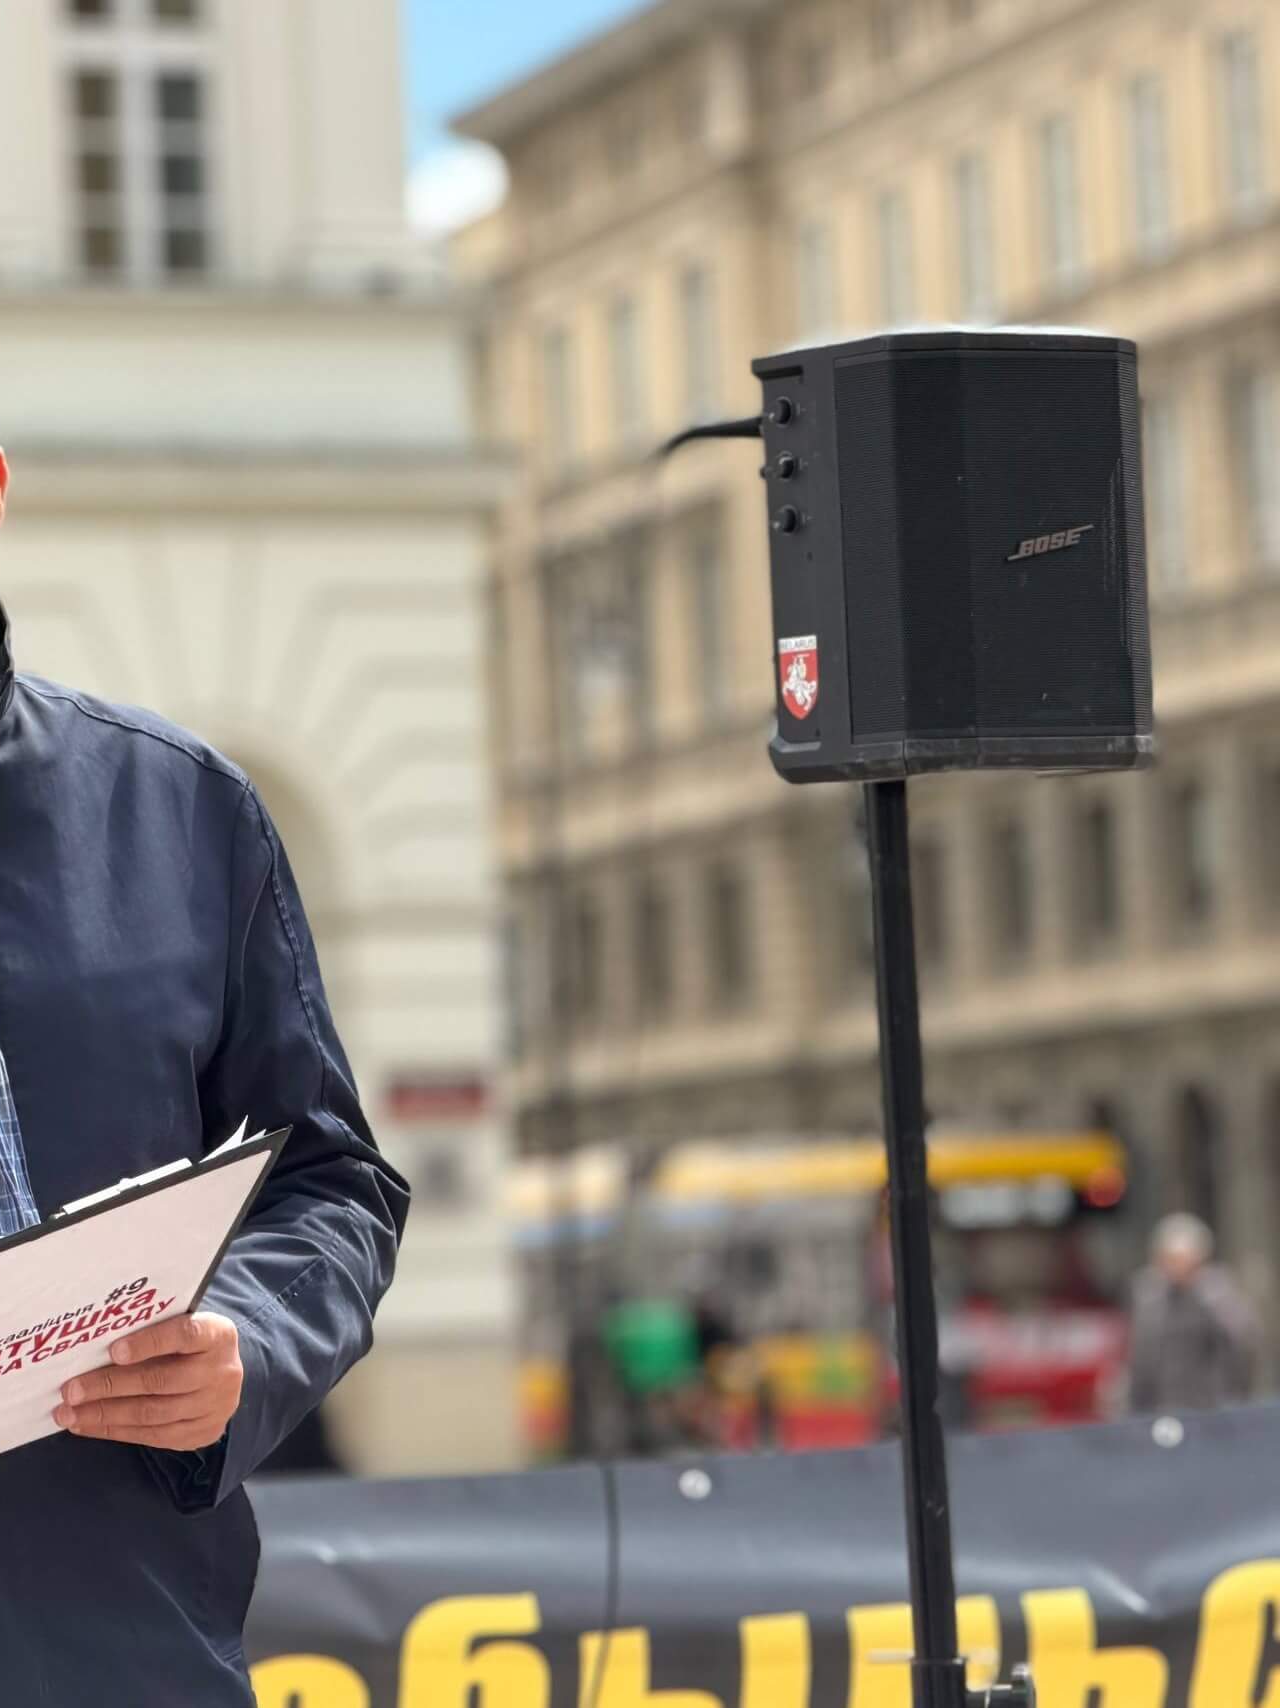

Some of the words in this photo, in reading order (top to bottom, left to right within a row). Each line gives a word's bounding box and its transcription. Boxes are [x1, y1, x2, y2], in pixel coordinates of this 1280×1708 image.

[1008, 524, 1094, 561] BOSE
[105, 1276, 148, 1304] #9
[31, 1296, 176, 1363] СВАБОДУ
